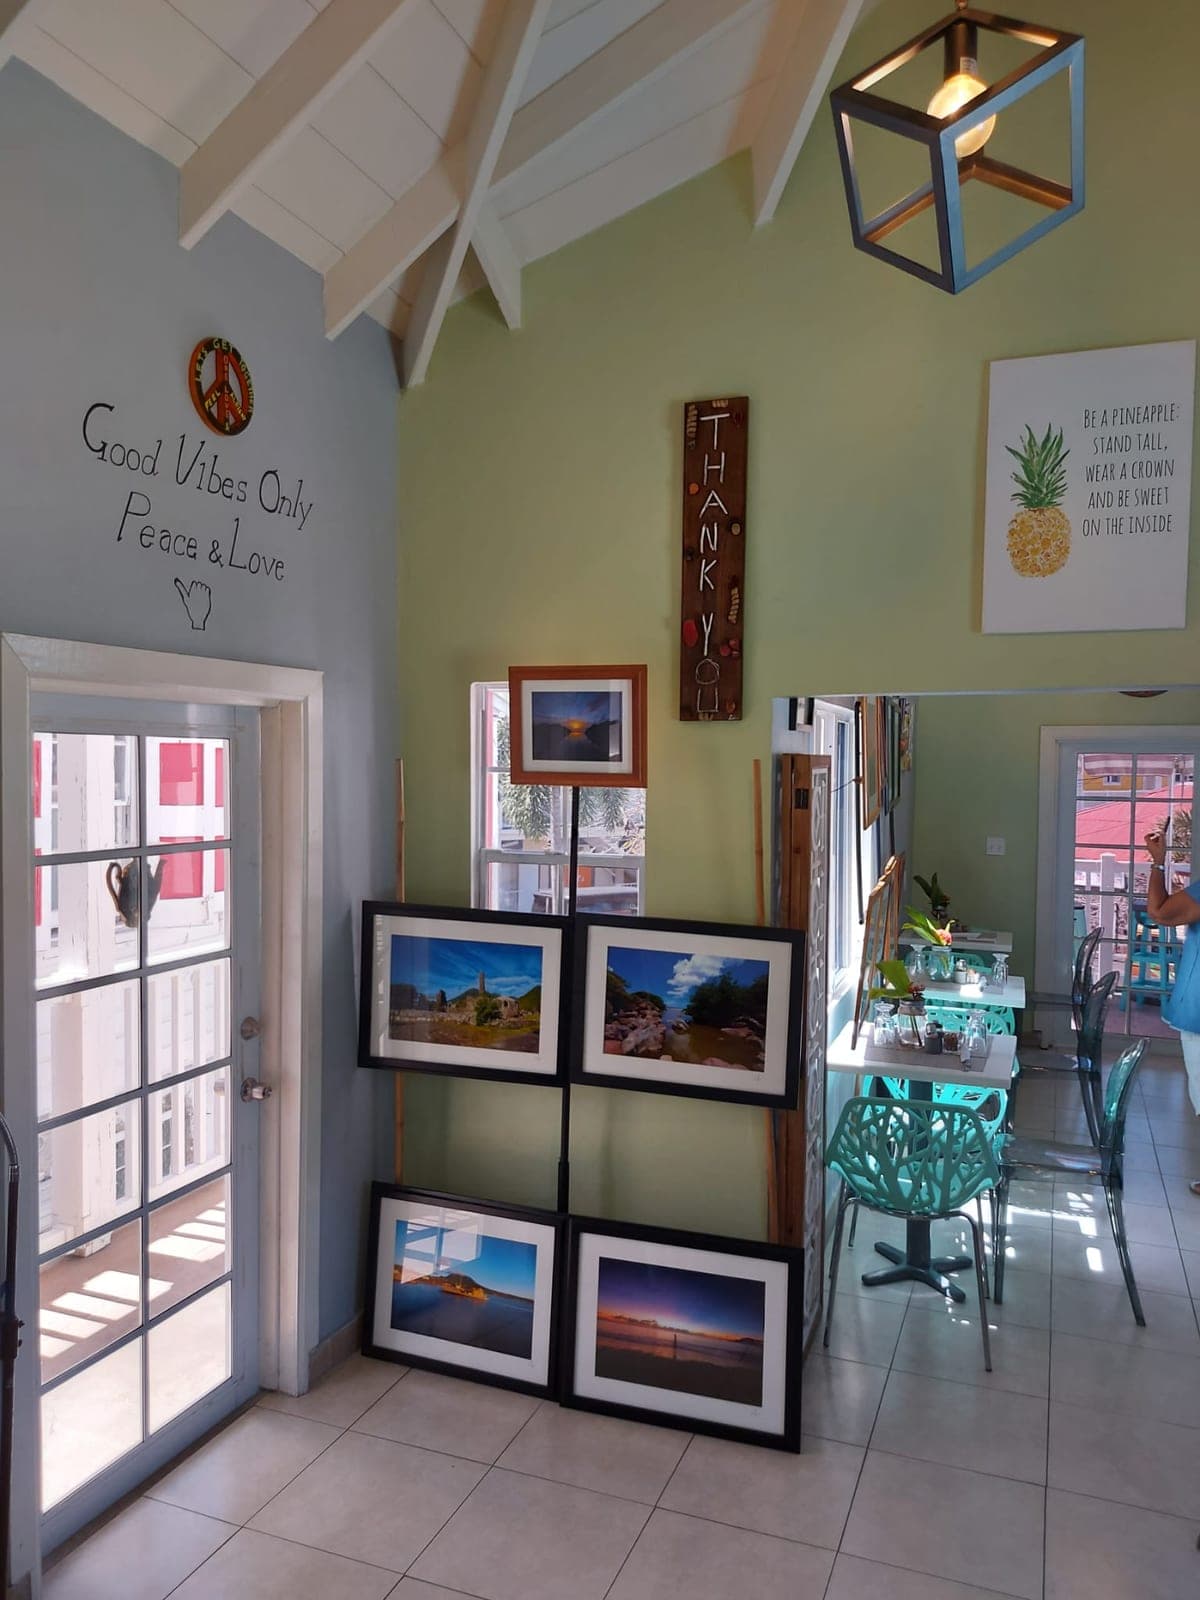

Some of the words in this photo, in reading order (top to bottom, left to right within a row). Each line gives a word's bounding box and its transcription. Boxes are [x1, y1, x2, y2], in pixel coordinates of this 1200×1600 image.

[213, 338, 233, 354] GET
[1084, 409, 1096, 428] BE
[1100, 409, 1108, 427] A
[1112, 403, 1180, 426] PINEAPPLE:
[1093, 435, 1132, 455] STAND
[1136, 432, 1168, 452] TALL,
[82, 402, 163, 476] Good
[175, 434, 247, 502] Vibes
[259, 469, 313, 530] Only
[1085, 463, 1115, 483] WEAR
[1119, 462, 1127, 480] A
[1131, 459, 1175, 480] CROWN
[699, 413, 730, 592] THANK
[1088, 491, 1113, 509] AND
[1118, 489, 1130, 508] BE
[1134, 486, 1169, 507] SWEET
[116, 491, 198, 560] Peace
[208, 539, 224, 568] &
[228, 517, 285, 581] Love
[1082, 519, 1101, 537] ON
[1105, 517, 1124, 535] THE
[1129, 514, 1173, 534] INSIDE
[695, 612, 720, 713] YOU
